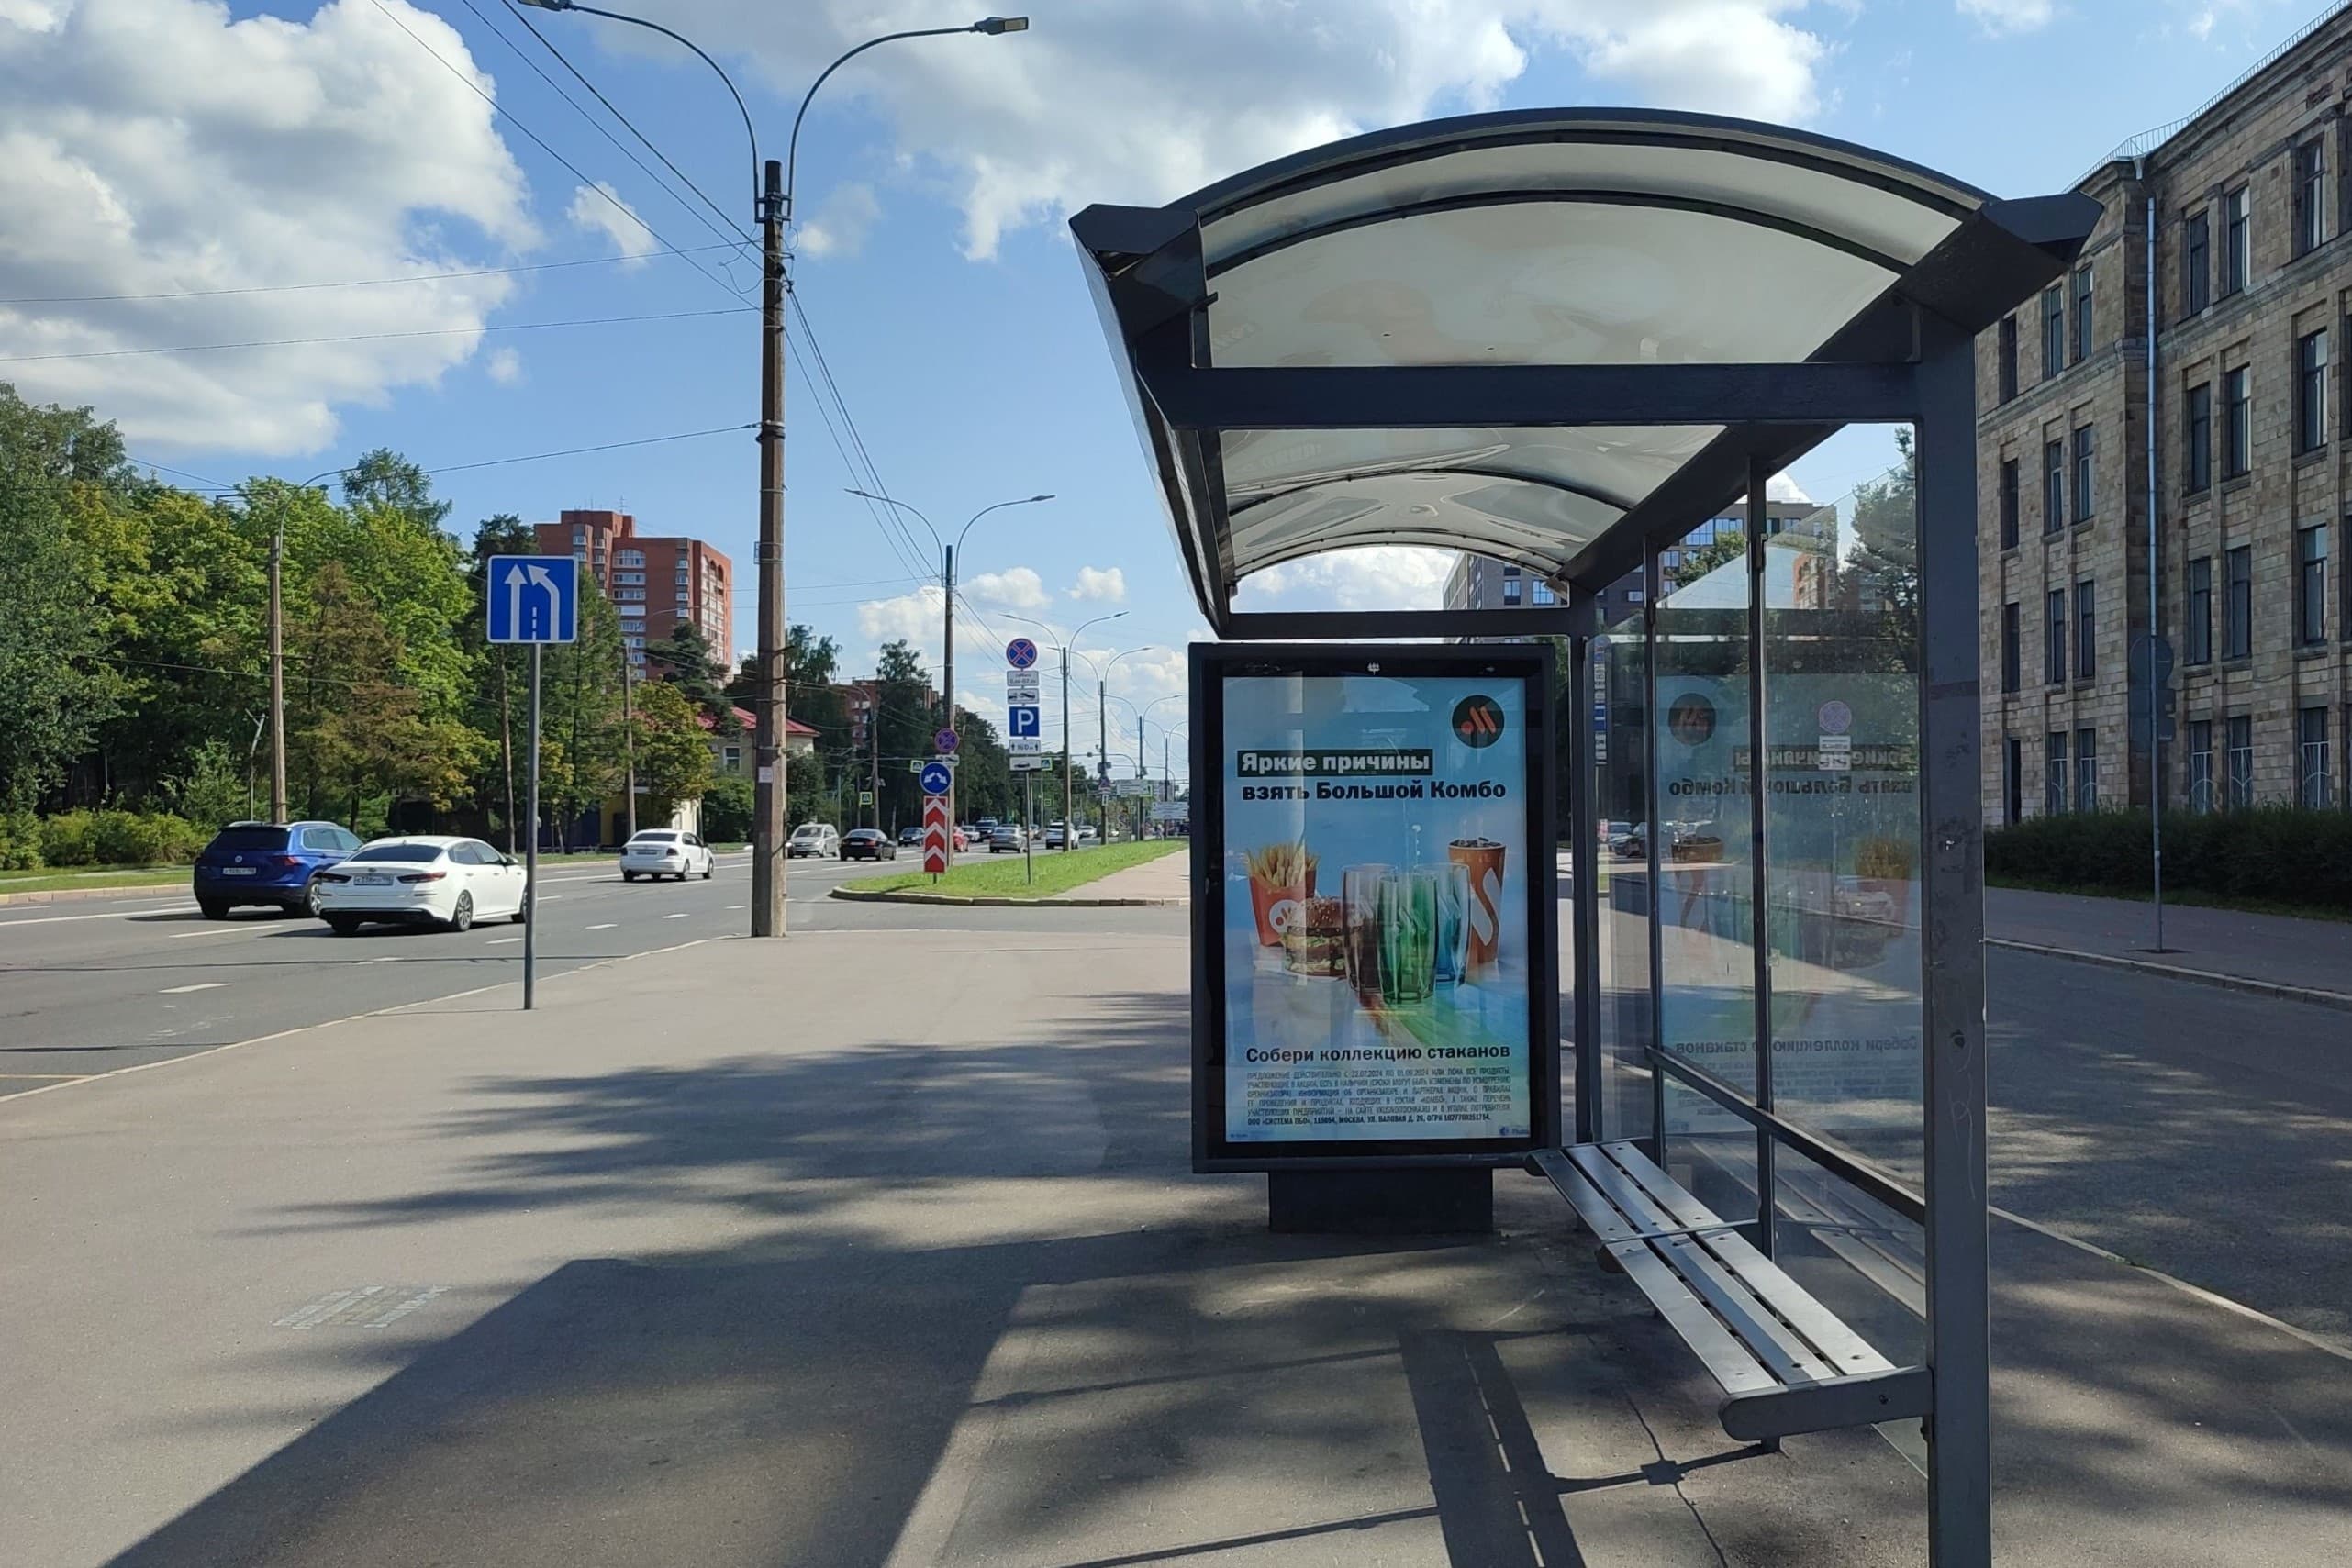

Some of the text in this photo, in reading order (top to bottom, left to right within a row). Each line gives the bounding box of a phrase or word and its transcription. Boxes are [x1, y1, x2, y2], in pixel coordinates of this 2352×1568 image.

[1018, 709, 1034, 734] P
[1242, 752, 1430, 774] Яркие причины
[1242, 780, 1507, 801] взять Большой Комбо
[1246, 1045, 1510, 1065] Собери коллекцию стаканов
